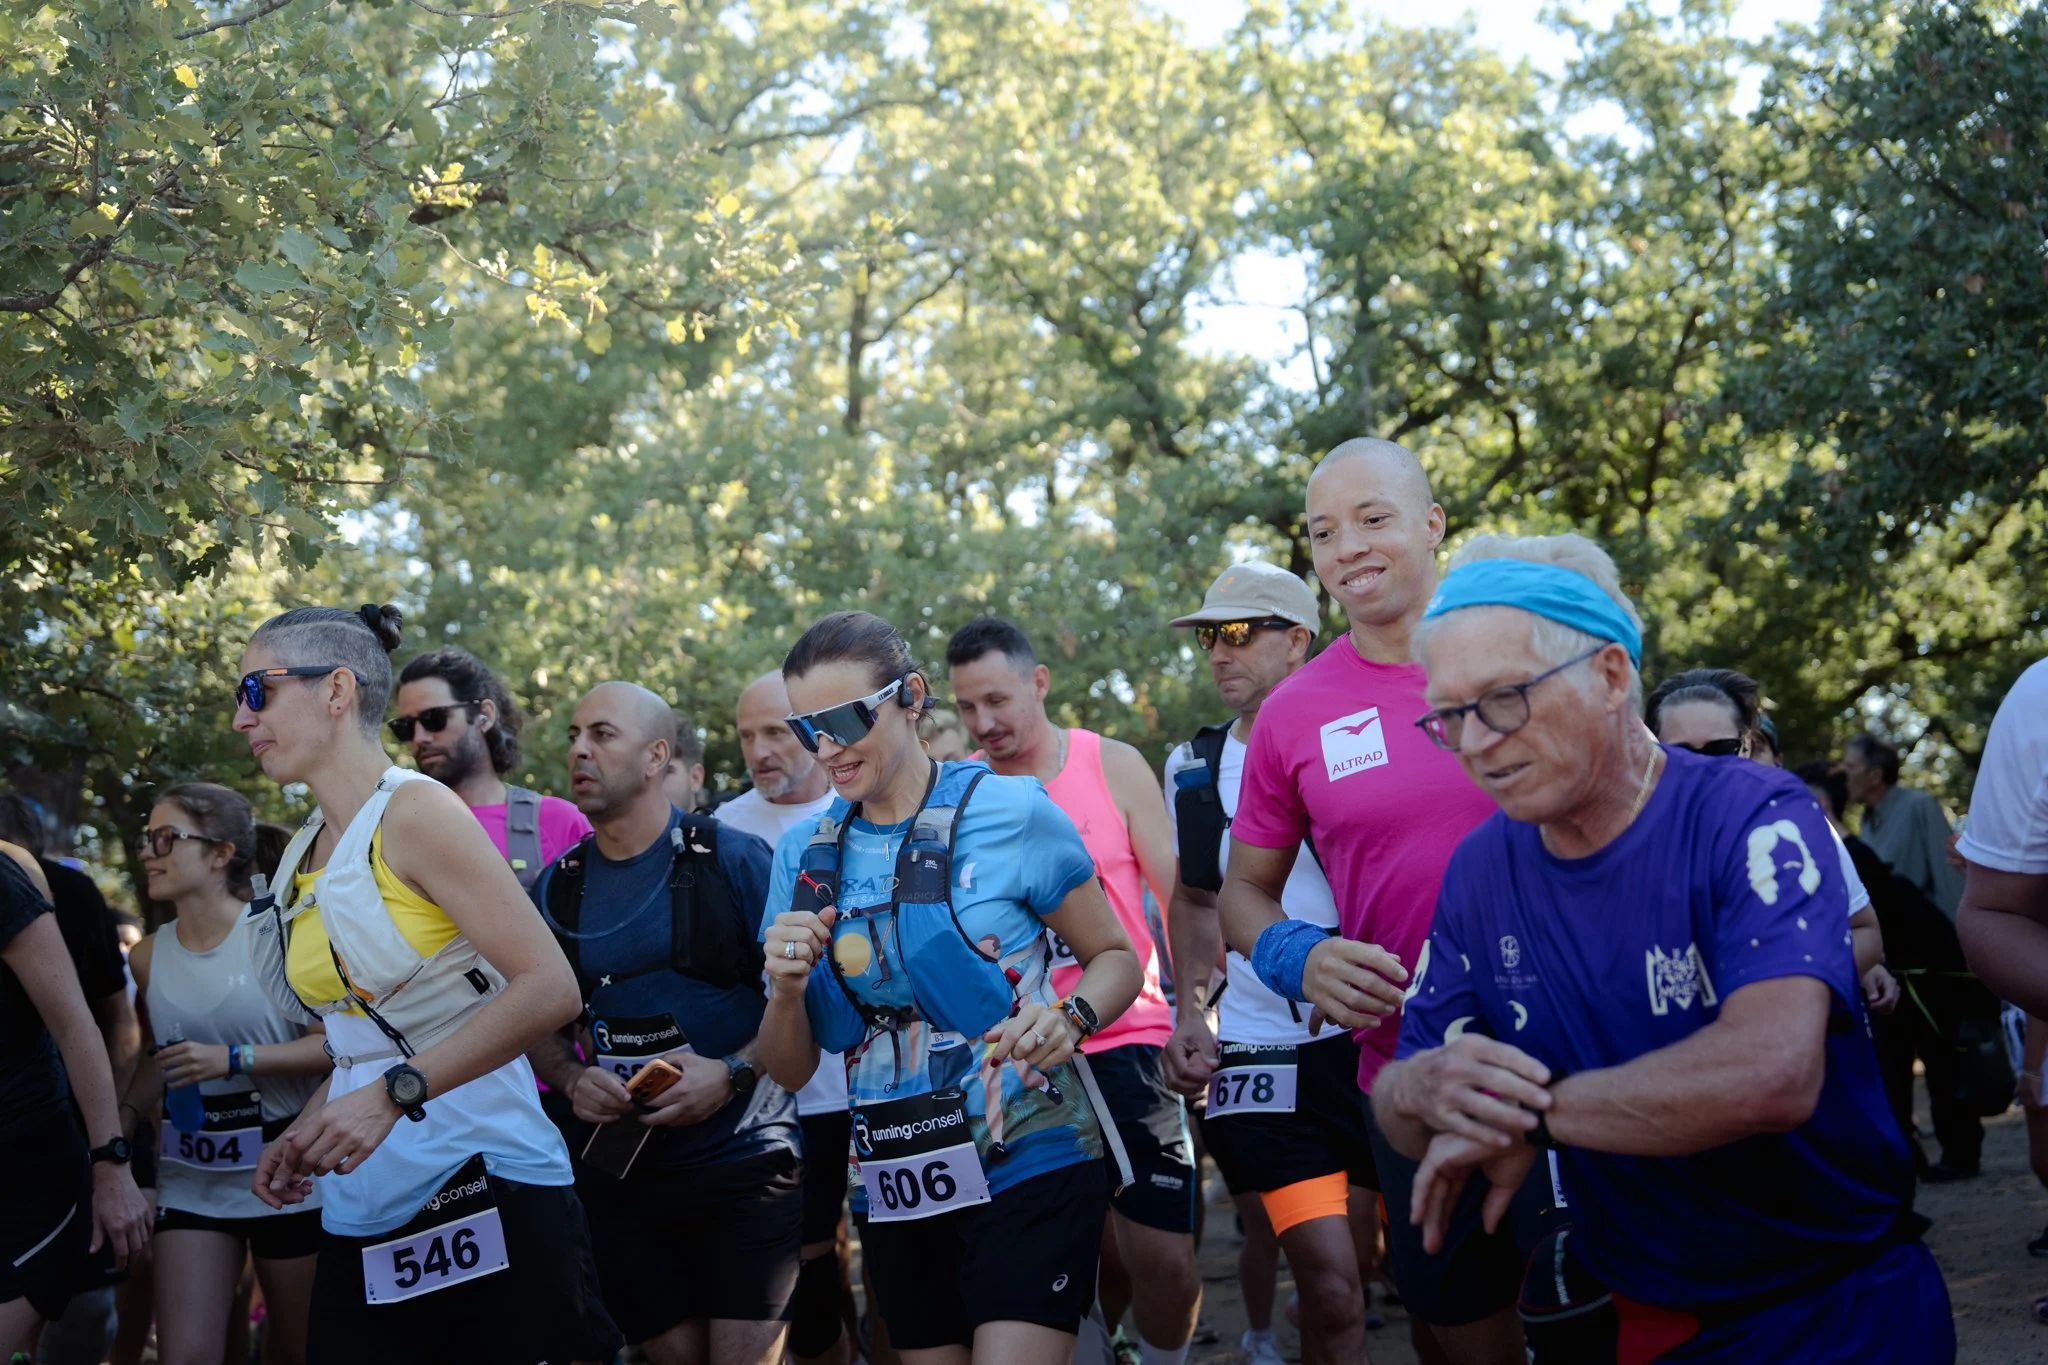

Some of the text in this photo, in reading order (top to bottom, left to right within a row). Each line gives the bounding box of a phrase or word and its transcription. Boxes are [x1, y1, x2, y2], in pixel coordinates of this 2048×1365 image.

[1332, 750, 1384, 776] ALTRAD
[611, 1026, 680, 1046] runningconseil
[1216, 1072, 1275, 1107] 678
[871, 1108, 965, 1141] runningconseil
[179, 1132, 243, 1164] 504
[878, 1160, 957, 1211] 606
[392, 1227, 481, 1289] 546
